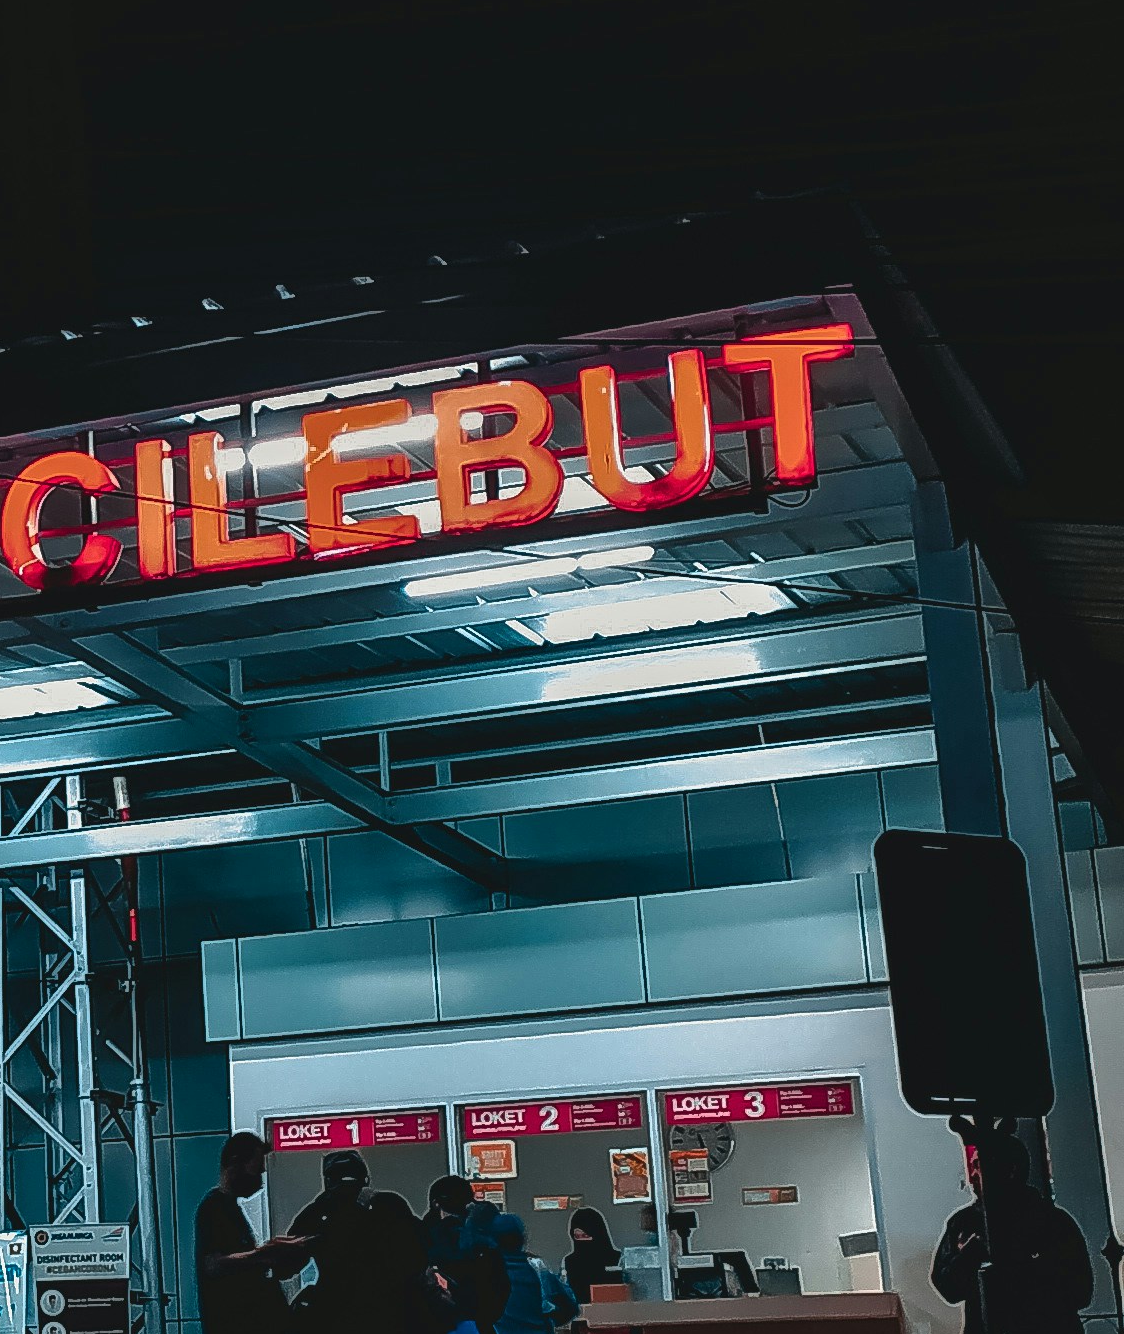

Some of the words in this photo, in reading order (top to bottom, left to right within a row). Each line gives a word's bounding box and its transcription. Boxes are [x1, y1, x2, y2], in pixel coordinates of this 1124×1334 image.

[2, 323, 855, 591] CILEBUT
[671, 1094, 730, 1113] LOKET
[743, 1091, 766, 1118] 3
[471, 1109, 526, 1127] LOKET
[538, 1105, 559, 1131] 2
[279, 1122, 332, 1140] LOKET
[345, 1119, 360, 1145] 1
[36, 1253, 98, 1265] DISINFECTANT
[99, 1253, 124, 1263] ROOM
